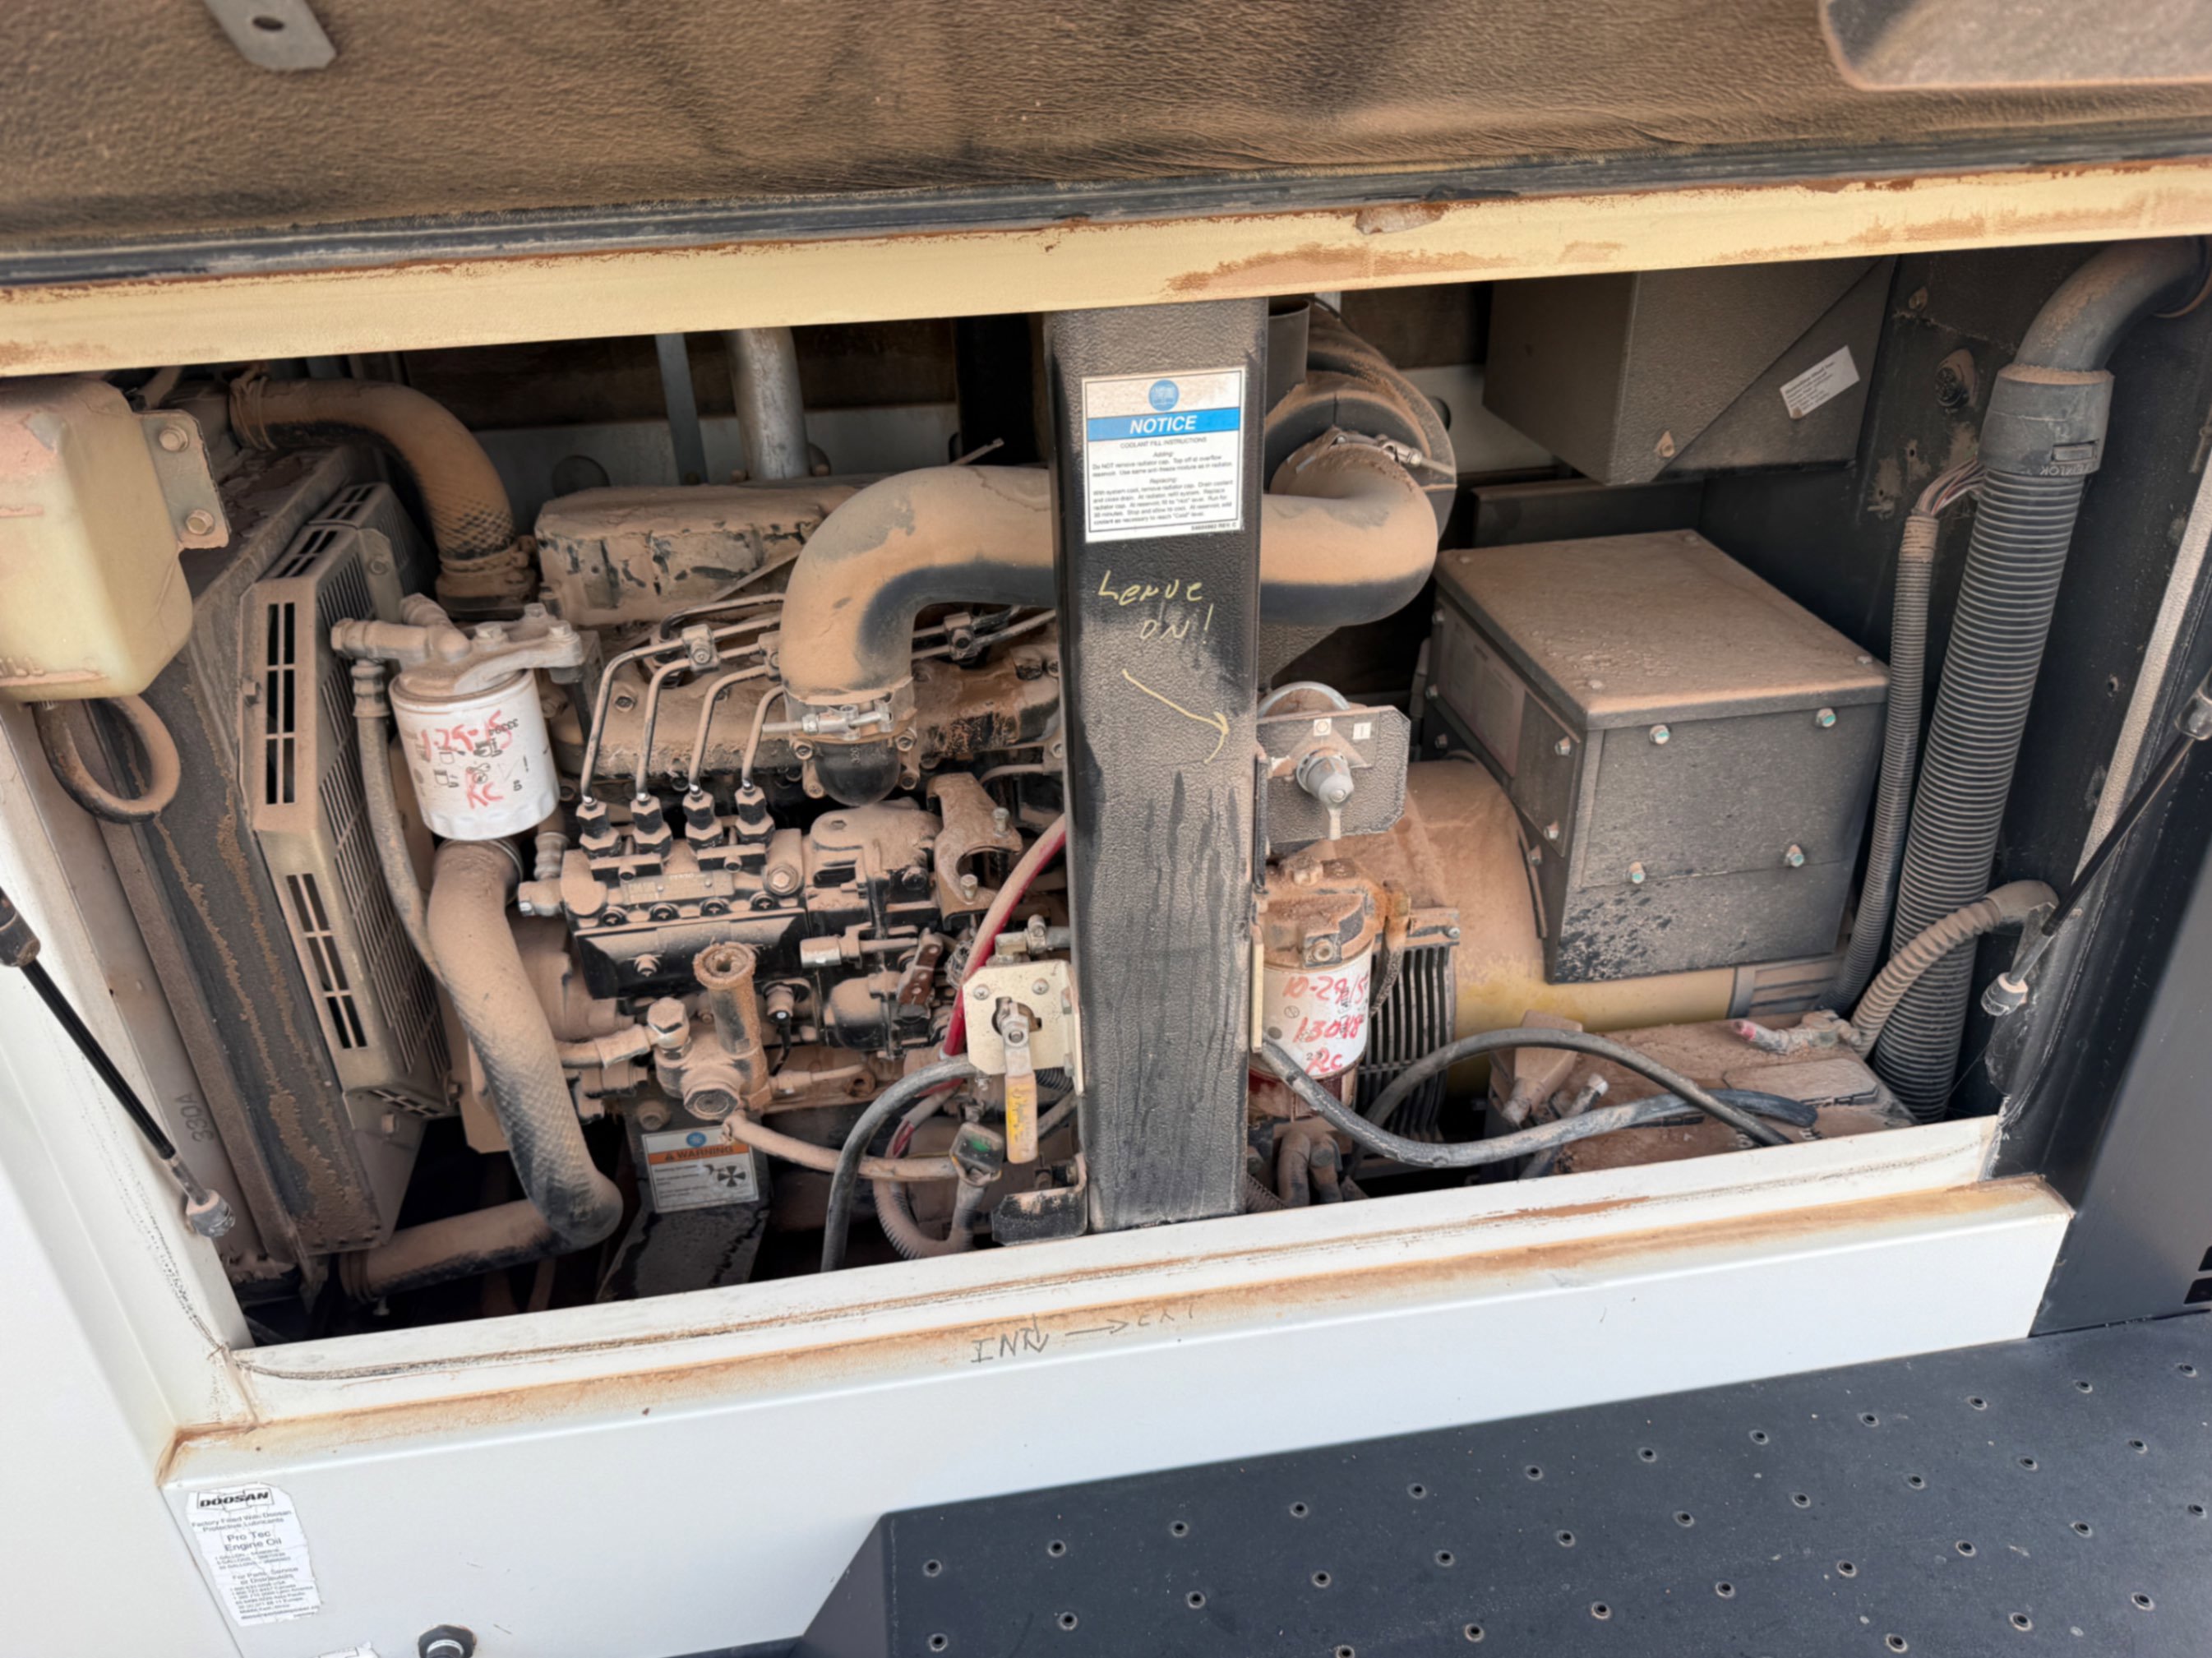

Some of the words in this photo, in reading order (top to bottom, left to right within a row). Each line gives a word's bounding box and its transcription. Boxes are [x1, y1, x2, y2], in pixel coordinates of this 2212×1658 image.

[1129, 415, 1197, 435] NOTICE
[1120, 441, 1149, 449] COOLANT
[1163, 436, 1207, 446] INSTRUCTIONS
[677, 1146, 734, 1158] WARNING
[200, 1491, 269, 1508] DOOSAN
[192, 1519, 219, 1527] Factory
[202, 1523, 242, 1532] Protective
[244, 1517, 284, 1526] Lubricants
[227, 1534, 247, 1542] Pro
[250, 1531, 271, 1539] Tec
[224, 1540, 263, 1552] Engine
[266, 1538, 282, 1546] Oil
